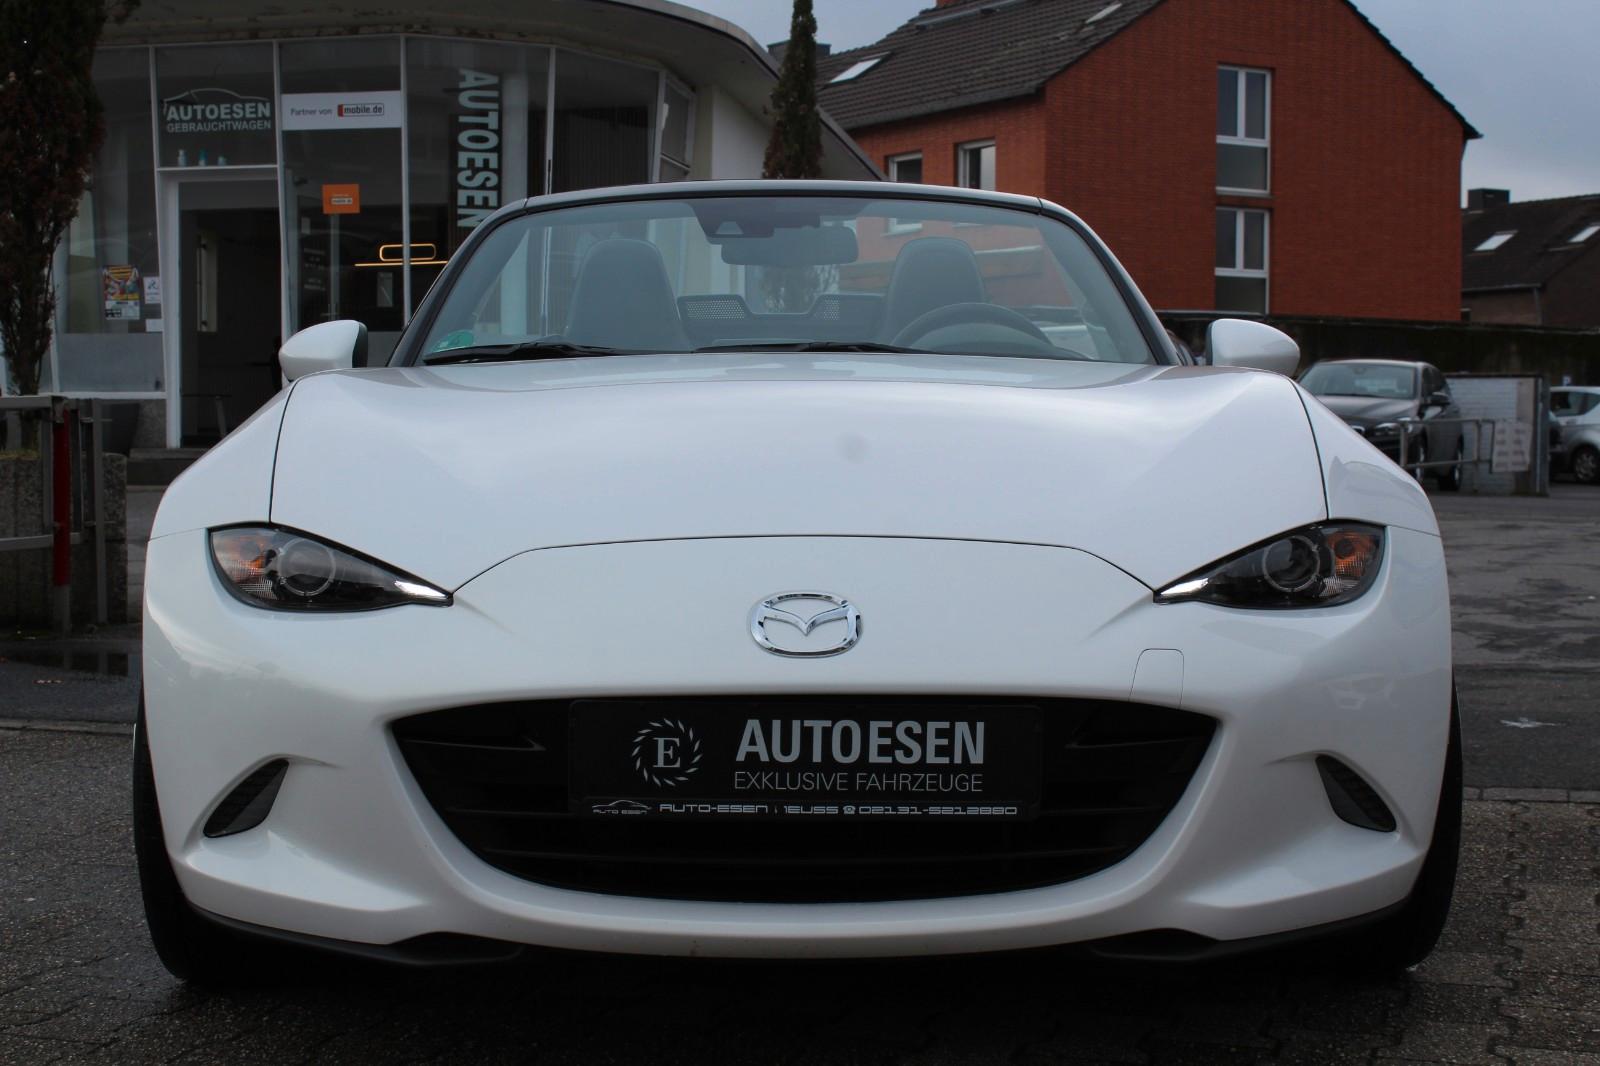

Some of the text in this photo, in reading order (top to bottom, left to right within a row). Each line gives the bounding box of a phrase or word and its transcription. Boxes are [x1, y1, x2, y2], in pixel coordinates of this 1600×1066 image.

[166, 102, 271, 121] AUTOESEN
[290, 108, 316, 116] Partner
[344, 103, 383, 114] mobile.de
[166, 120, 271, 133] GEBRAUCHTWAGEN
[457, 68, 499, 227] AUTOESEN
[652, 737, 681, 768] E
[735, 719, 985, 765] AUTOESEN
[734, 770, 984, 793] EXKLUSIVE FAHRZEUGE
[658, 803, 769, 814] AUTO-ESEN
[858, 805, 1018, 816] 02131-5212880
